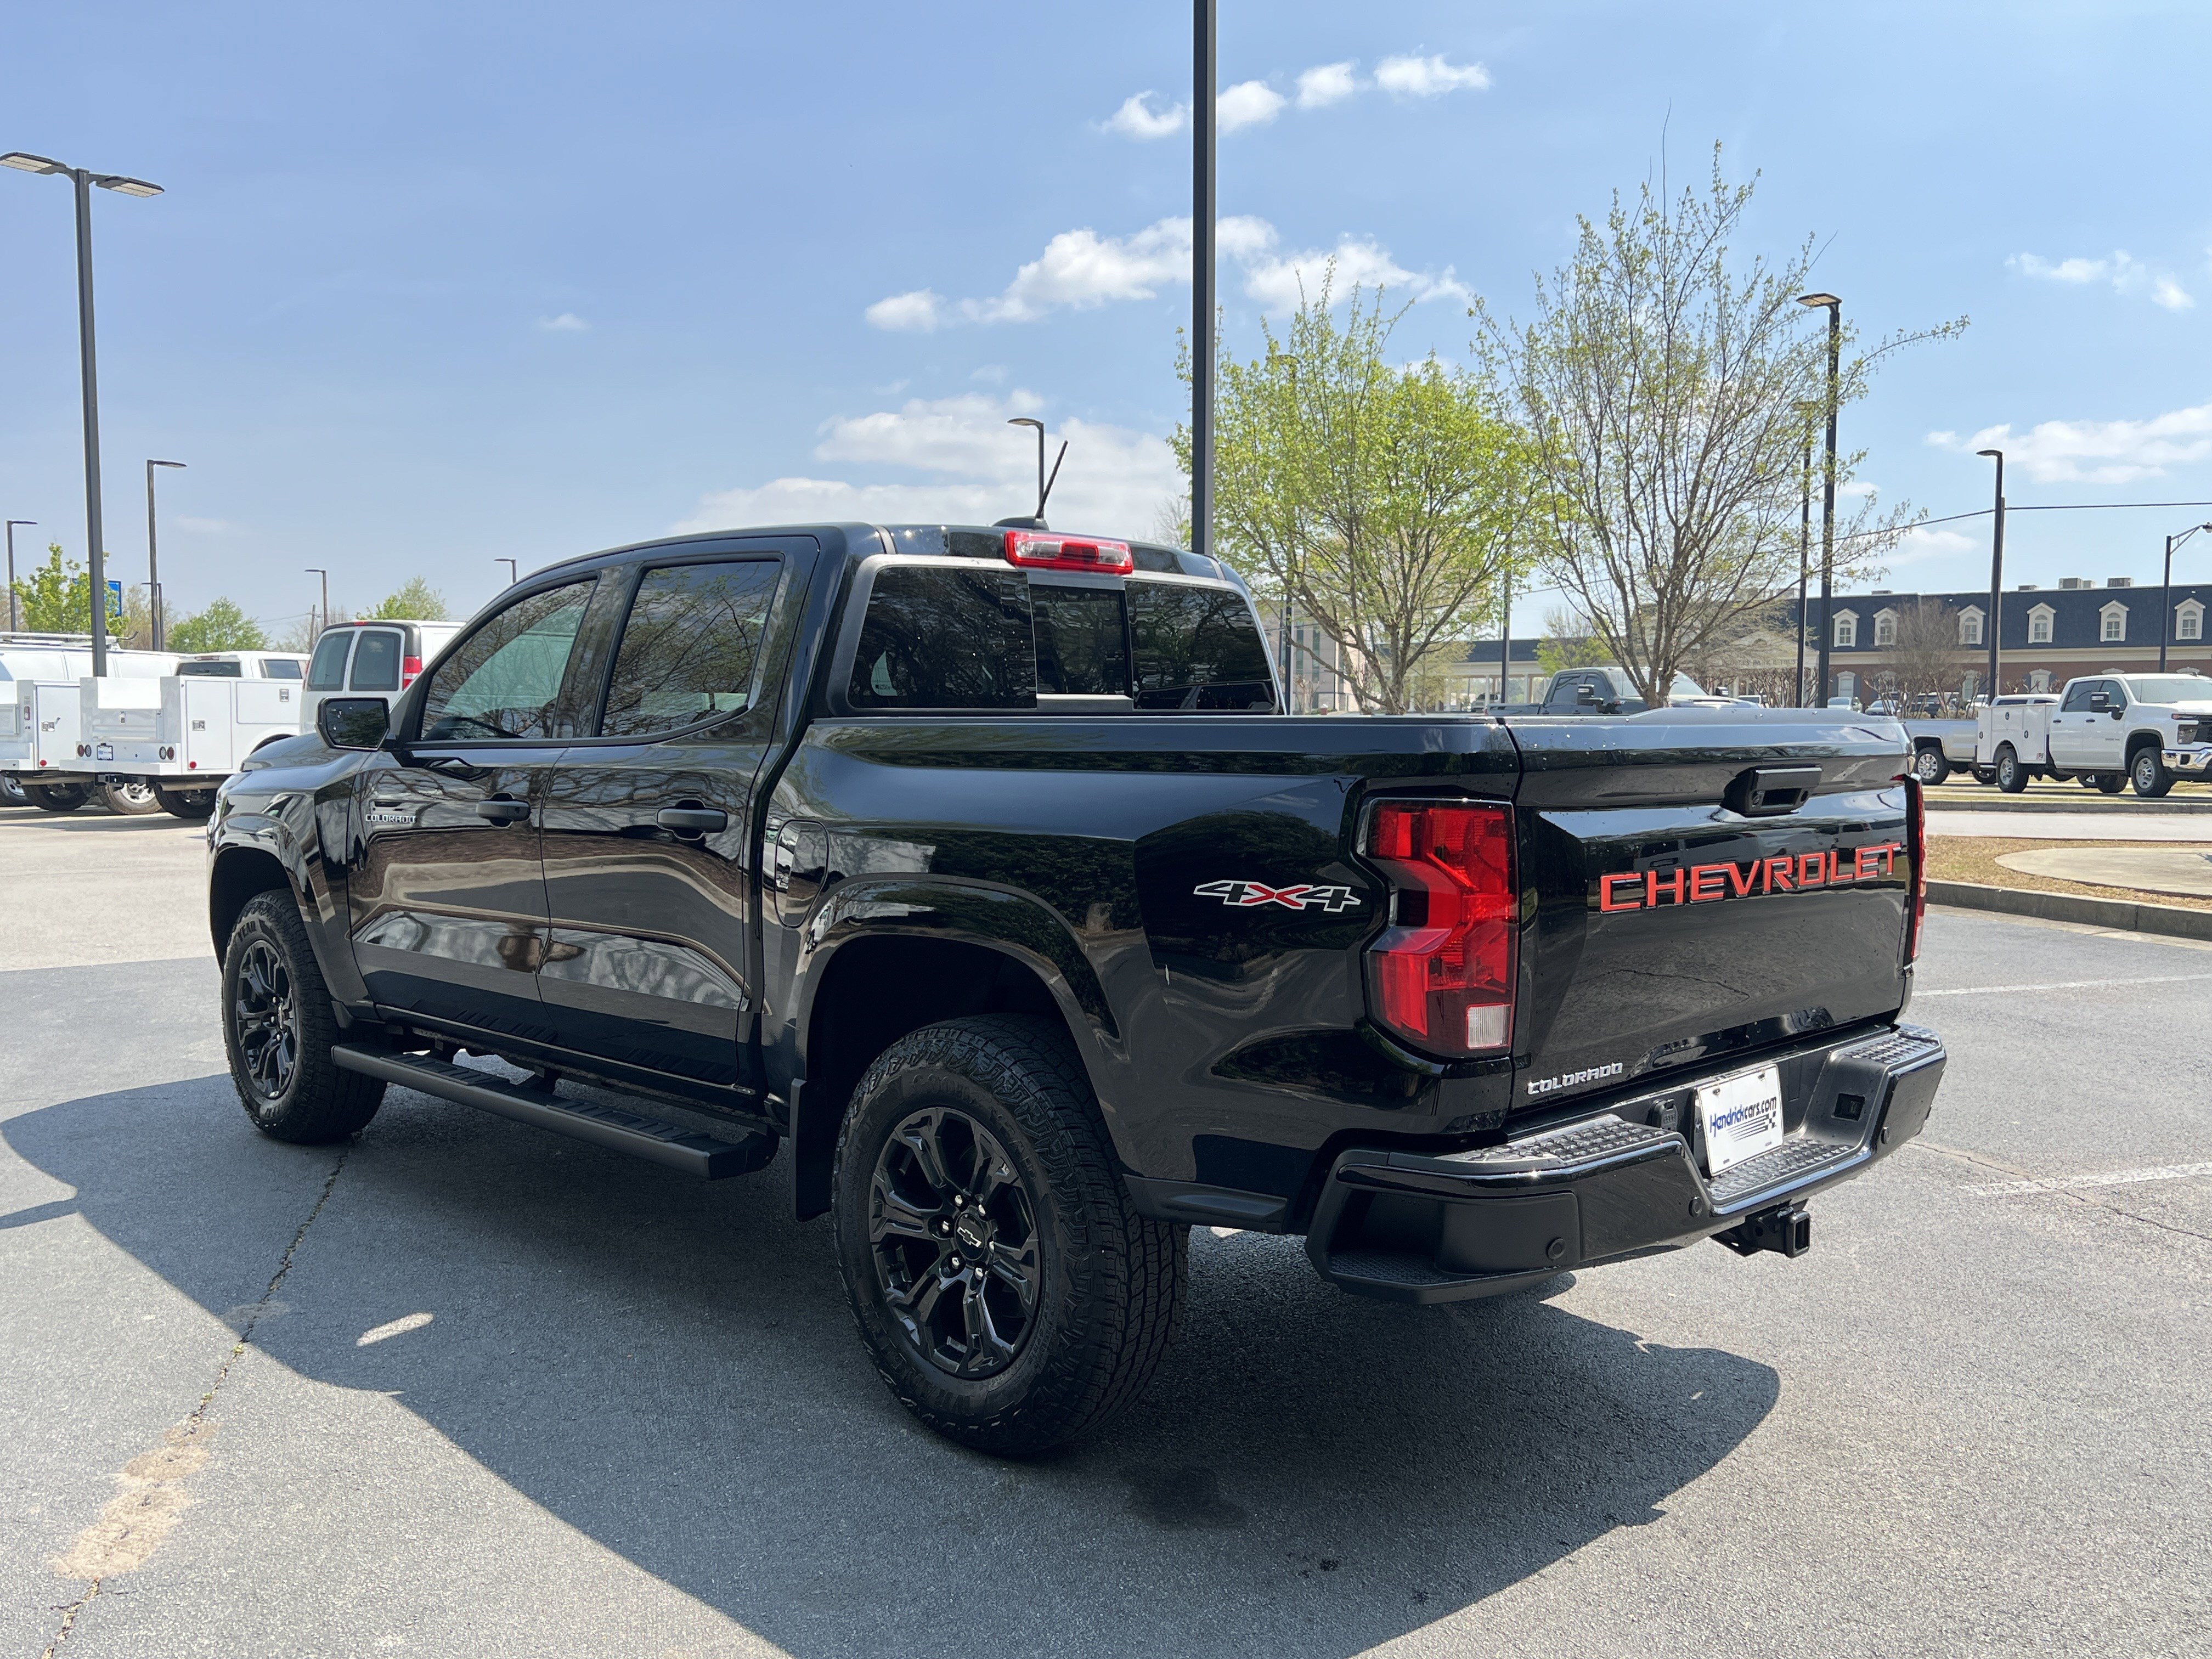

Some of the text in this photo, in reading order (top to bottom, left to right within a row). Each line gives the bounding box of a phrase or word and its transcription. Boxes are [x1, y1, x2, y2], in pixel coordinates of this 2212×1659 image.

[366, 814, 416, 823] COLORADO
[1599, 841, 1903, 915] CHEVROLET
[1527, 1062, 1623, 1095] COLORADO
[1709, 1096, 1777, 1138] Hendrickcars.com
